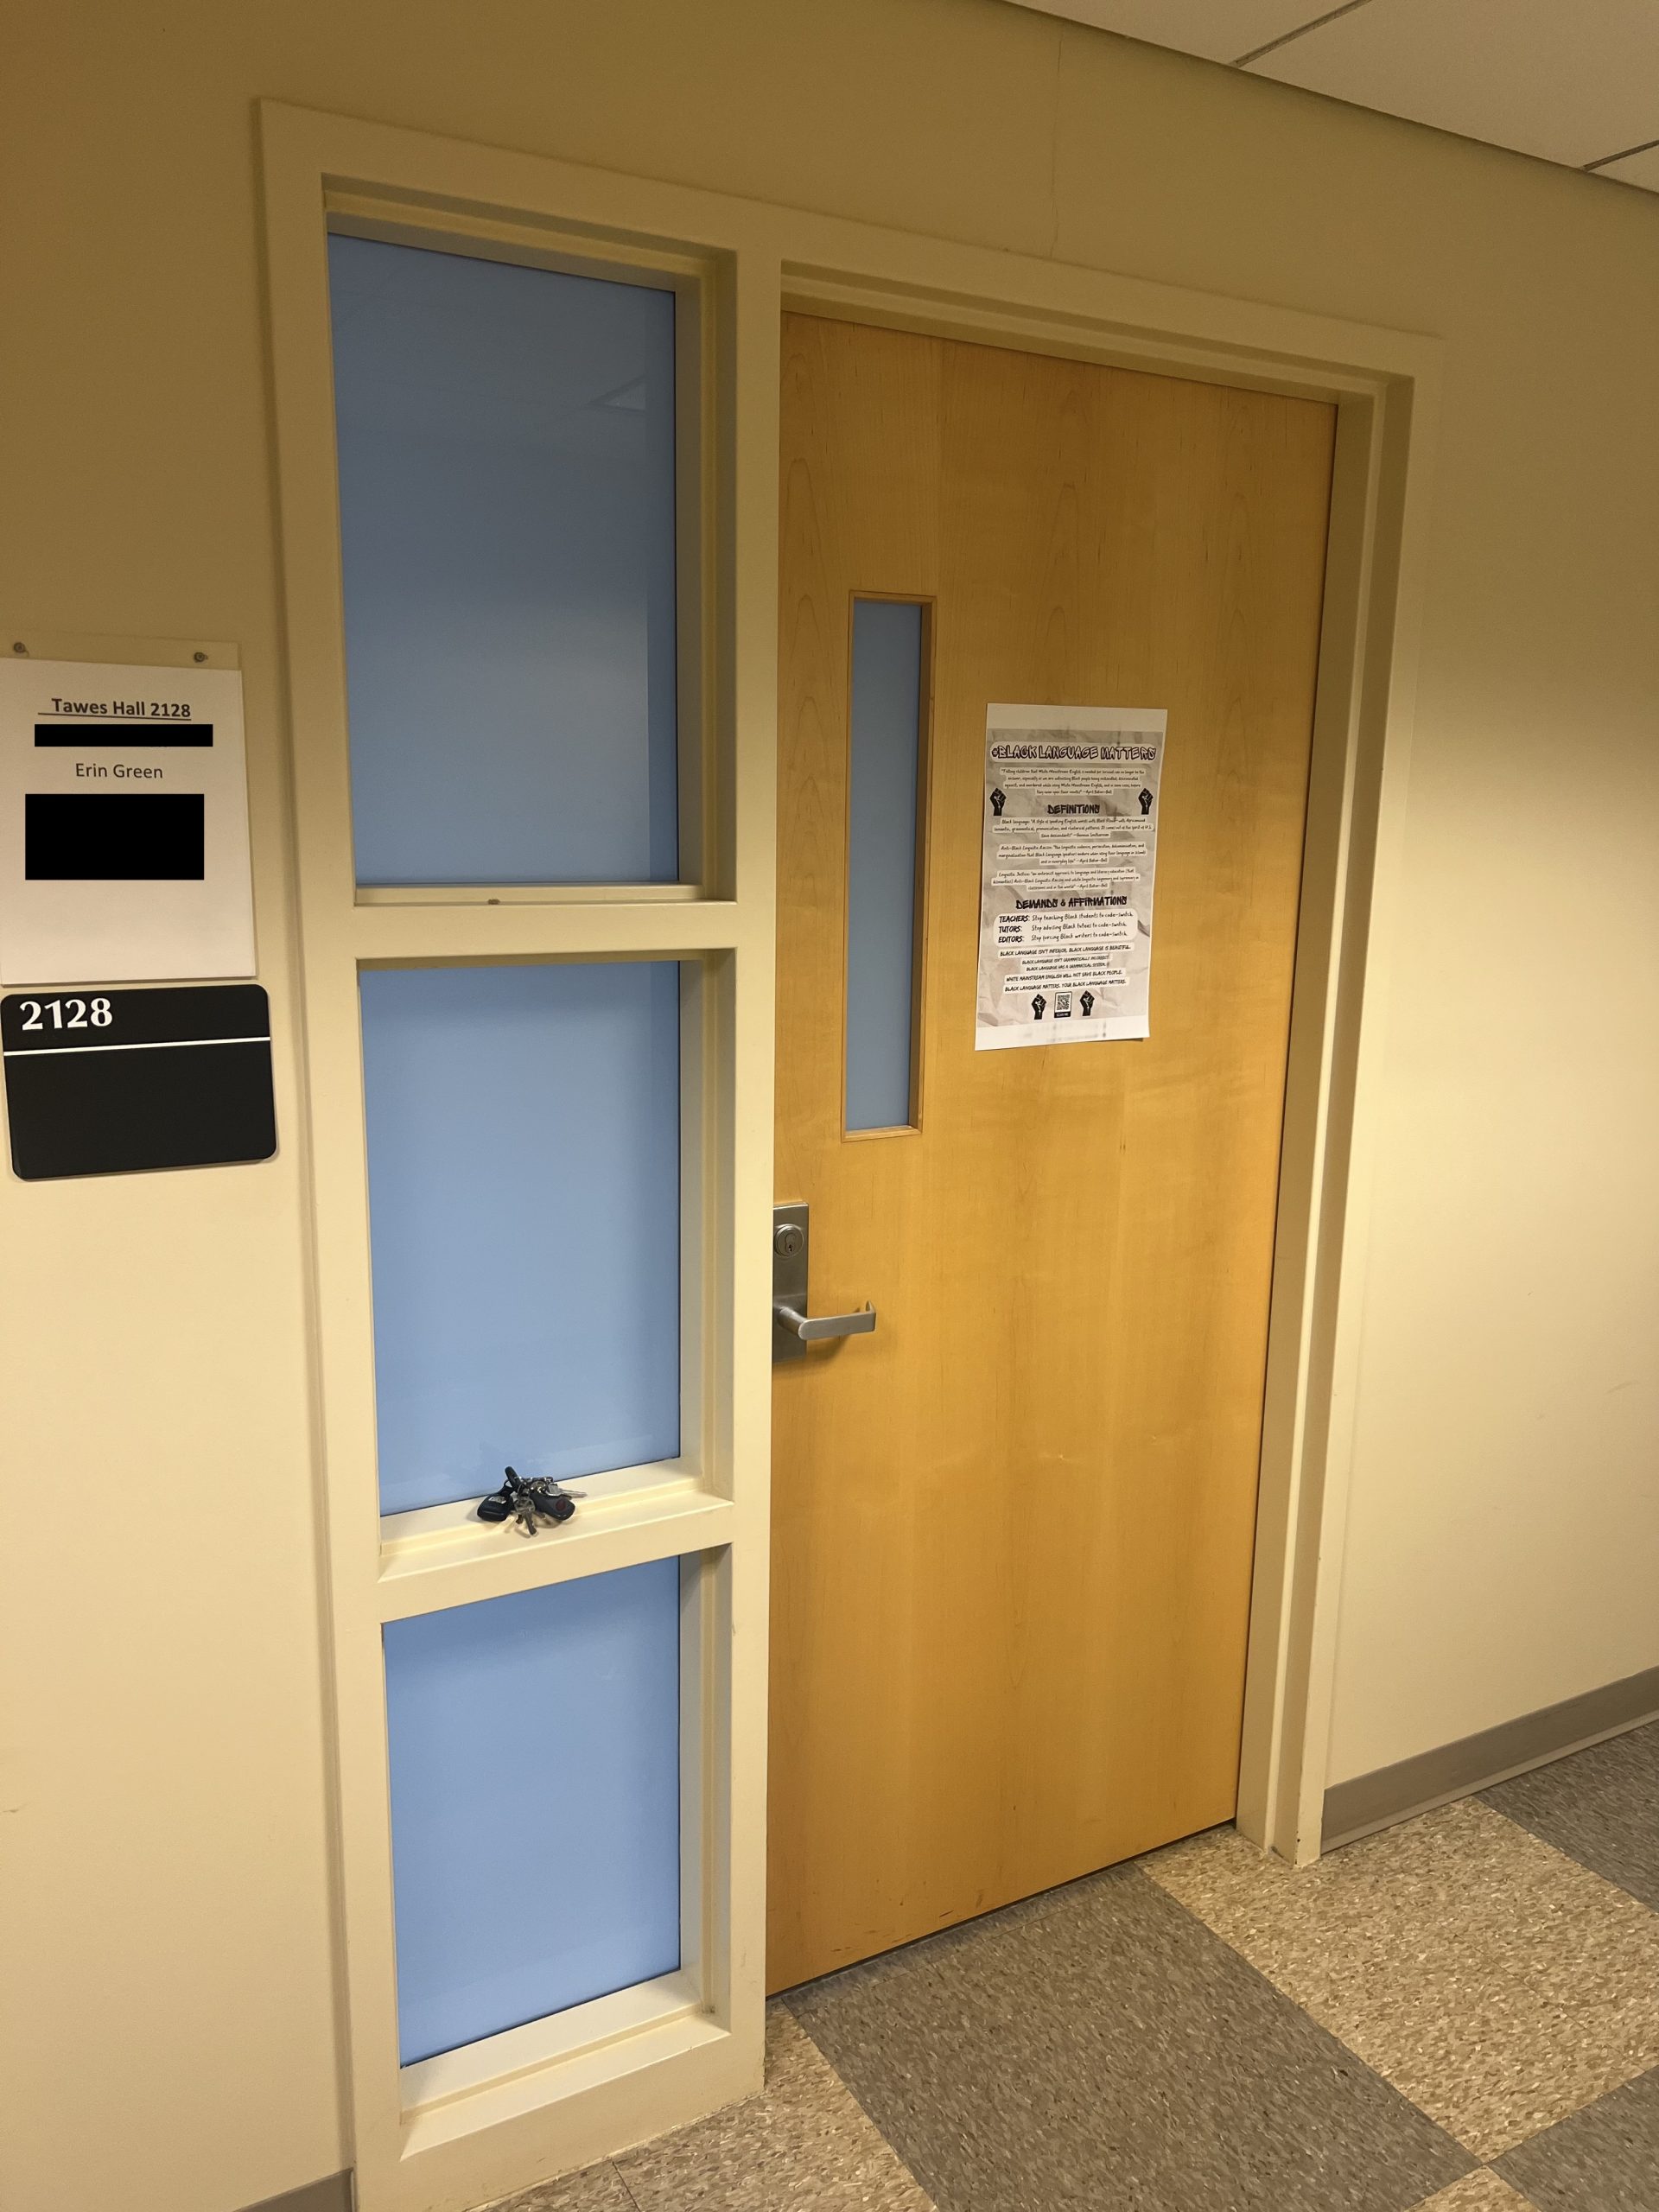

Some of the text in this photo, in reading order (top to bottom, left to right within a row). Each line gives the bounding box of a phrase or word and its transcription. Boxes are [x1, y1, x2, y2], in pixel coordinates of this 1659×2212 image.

[51, 698, 191, 717] Tawes Hall 2128
[992, 745, 1156, 760] #BLACK LANGUAGE MATTERS
[75, 763, 163, 779] Erin Green
[1046, 804, 1100, 815] DEFINITIONS
[1015, 896, 1128, 910] DEMANDS & AFFIRMATIONS
[999, 915, 1030, 924] TEACHERS:
[1032, 914, 1042, 923] Stop
[19, 998, 112, 1031] 2128
